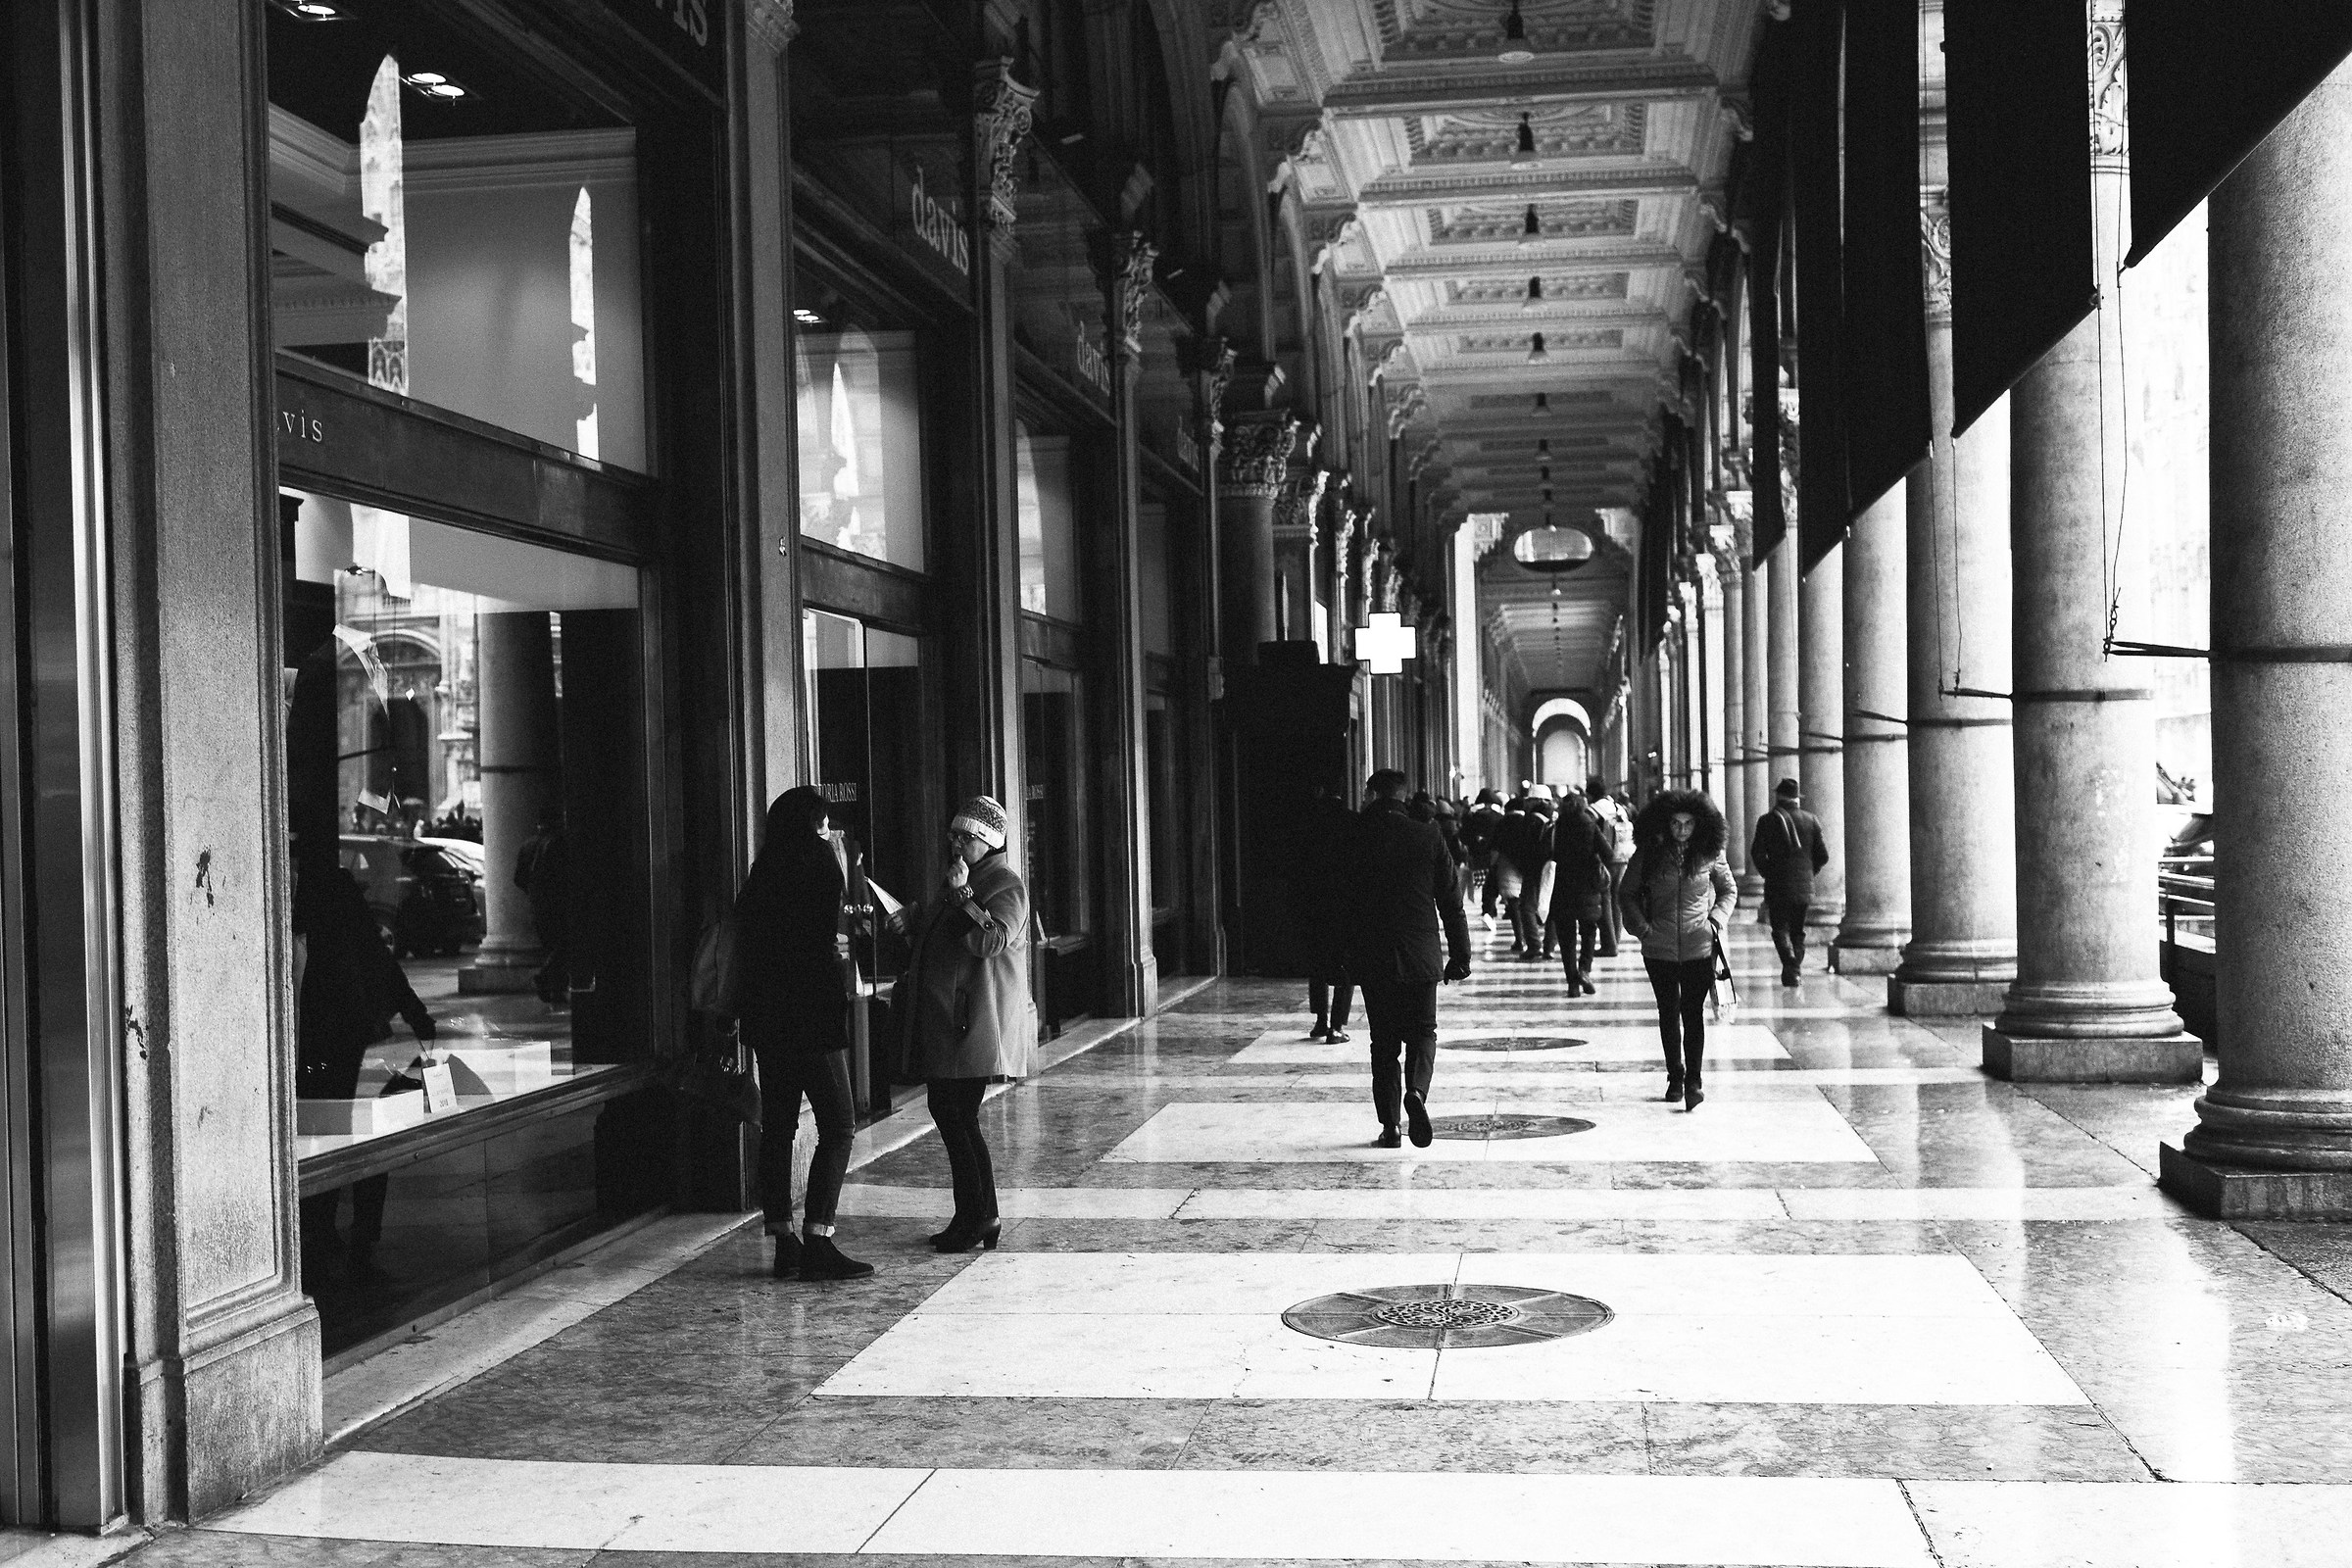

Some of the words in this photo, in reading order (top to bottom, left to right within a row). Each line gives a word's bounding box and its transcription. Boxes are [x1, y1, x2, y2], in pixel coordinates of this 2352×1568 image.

[912, 165, 969, 275] davis
[1078, 319, 1110, 397] davis
[276, 409, 323, 443] vis
